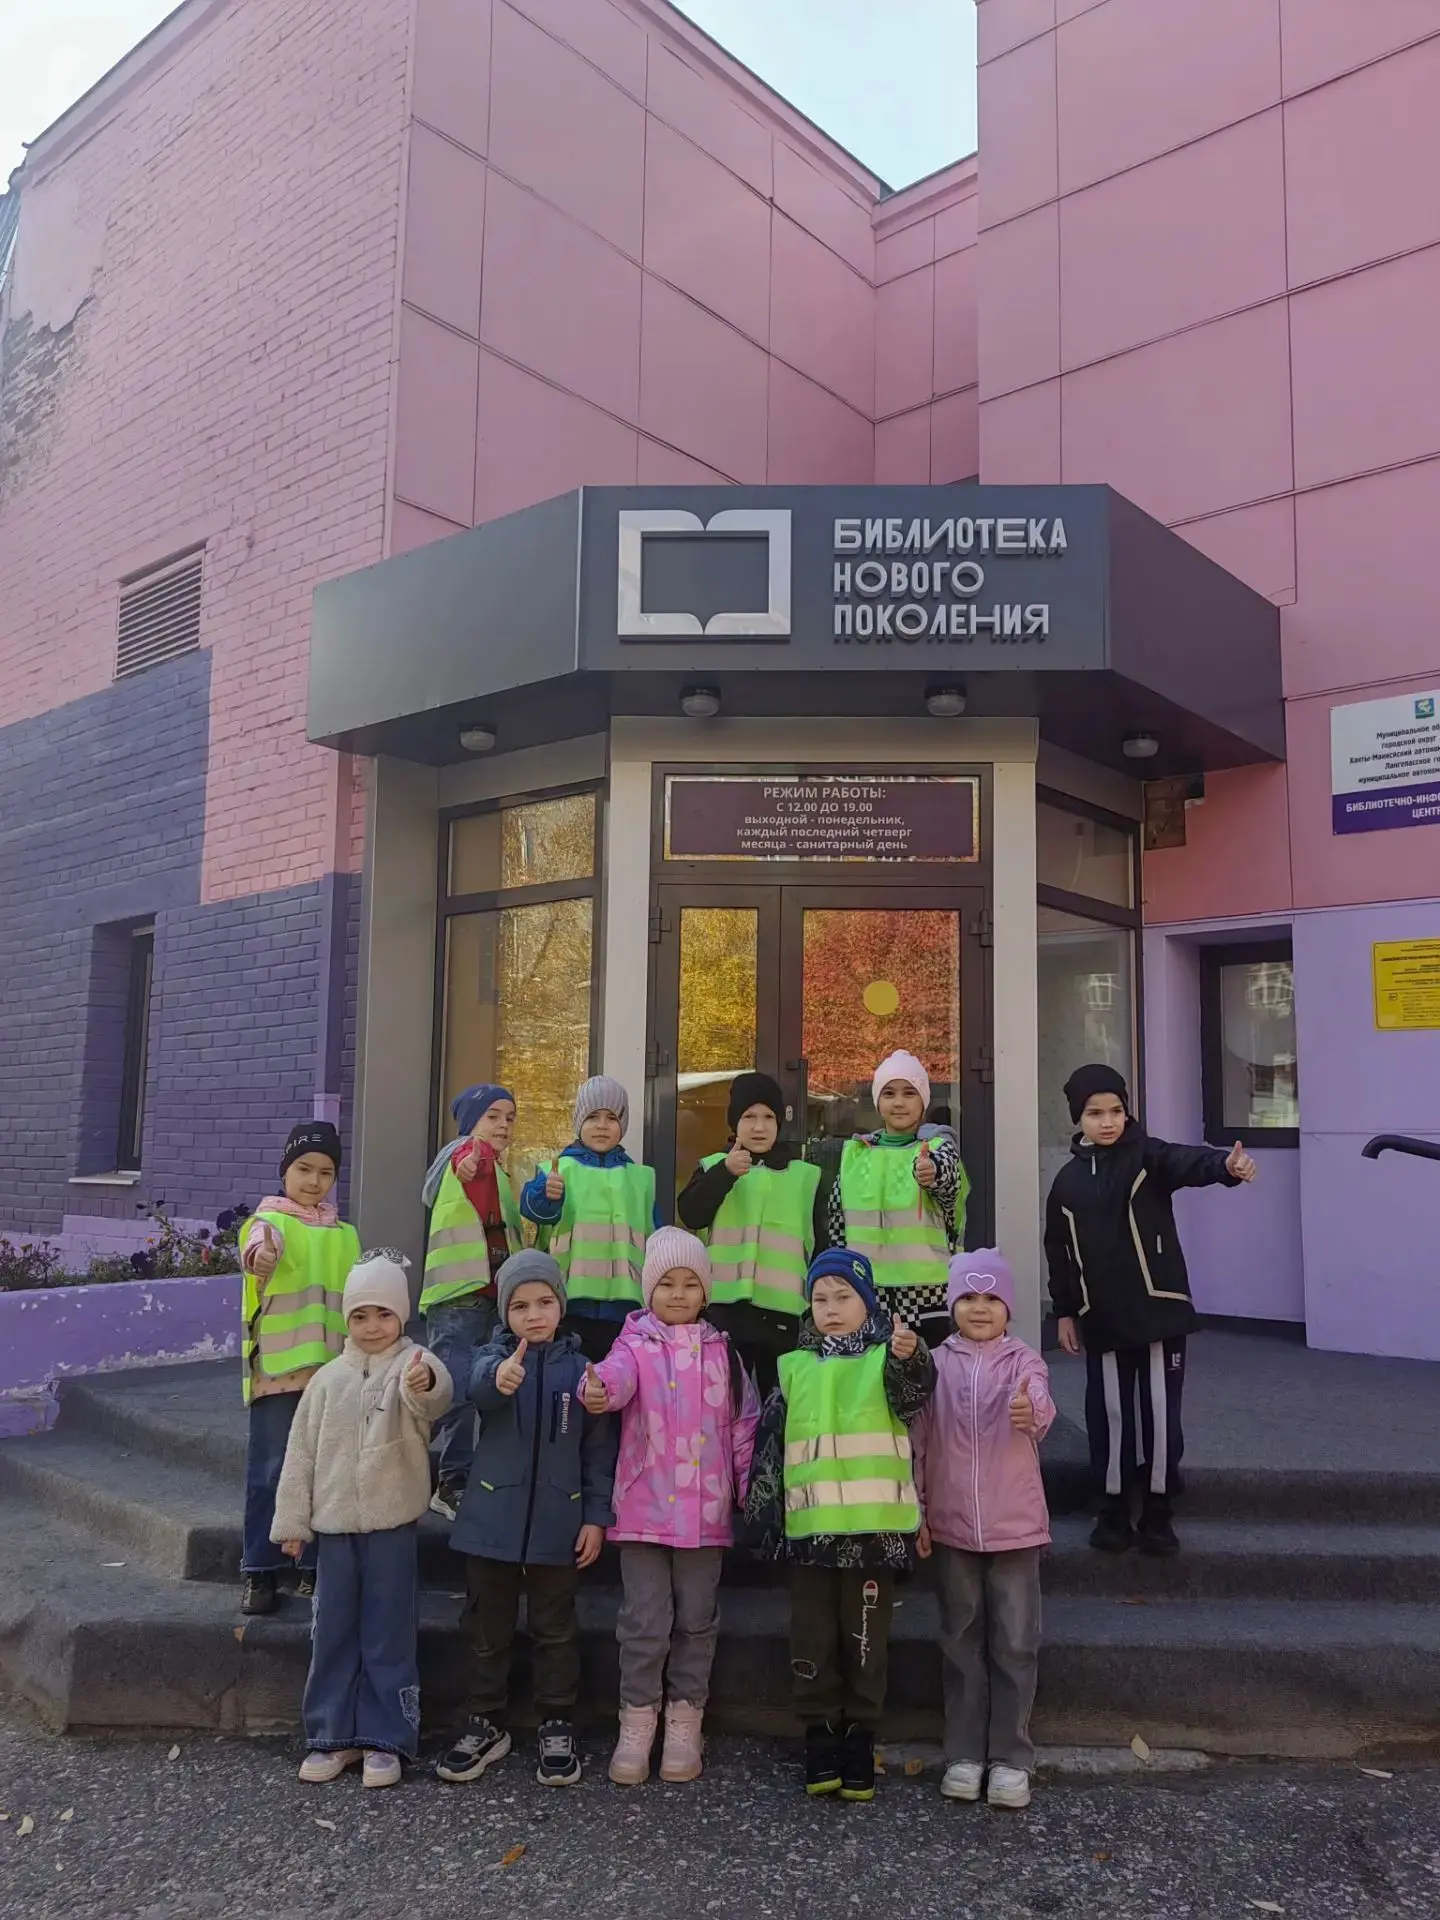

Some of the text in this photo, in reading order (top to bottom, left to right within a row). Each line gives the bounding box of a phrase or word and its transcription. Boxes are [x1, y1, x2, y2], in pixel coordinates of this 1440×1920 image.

[834, 517, 1067, 552] БИБЛИОТЕКА
[834, 561, 984, 596] НОВОГО
[834, 604, 1049, 637] ПОКОЛЕНИЯ
[1376, 725, 1430, 739] Муниципальное
[1381, 735, 1437, 749] городской округ
[1385, 757, 1431, 770] Лангепасское
[1358, 771, 1410, 784] муниципальное
[763, 787, 887, 798] РЕЖИМ РАБОТЫ:
[776, 803, 873, 813] С 12.00 ДО 19.00
[744, 815, 808, 826] выходной
[817, 816, 905, 826] понедельник,
[737, 827, 912, 839] каждый последний четверг
[741, 841, 787, 851] месяца
[796, 839, 874, 851] санитарный
[877, 841, 908, 851] день
